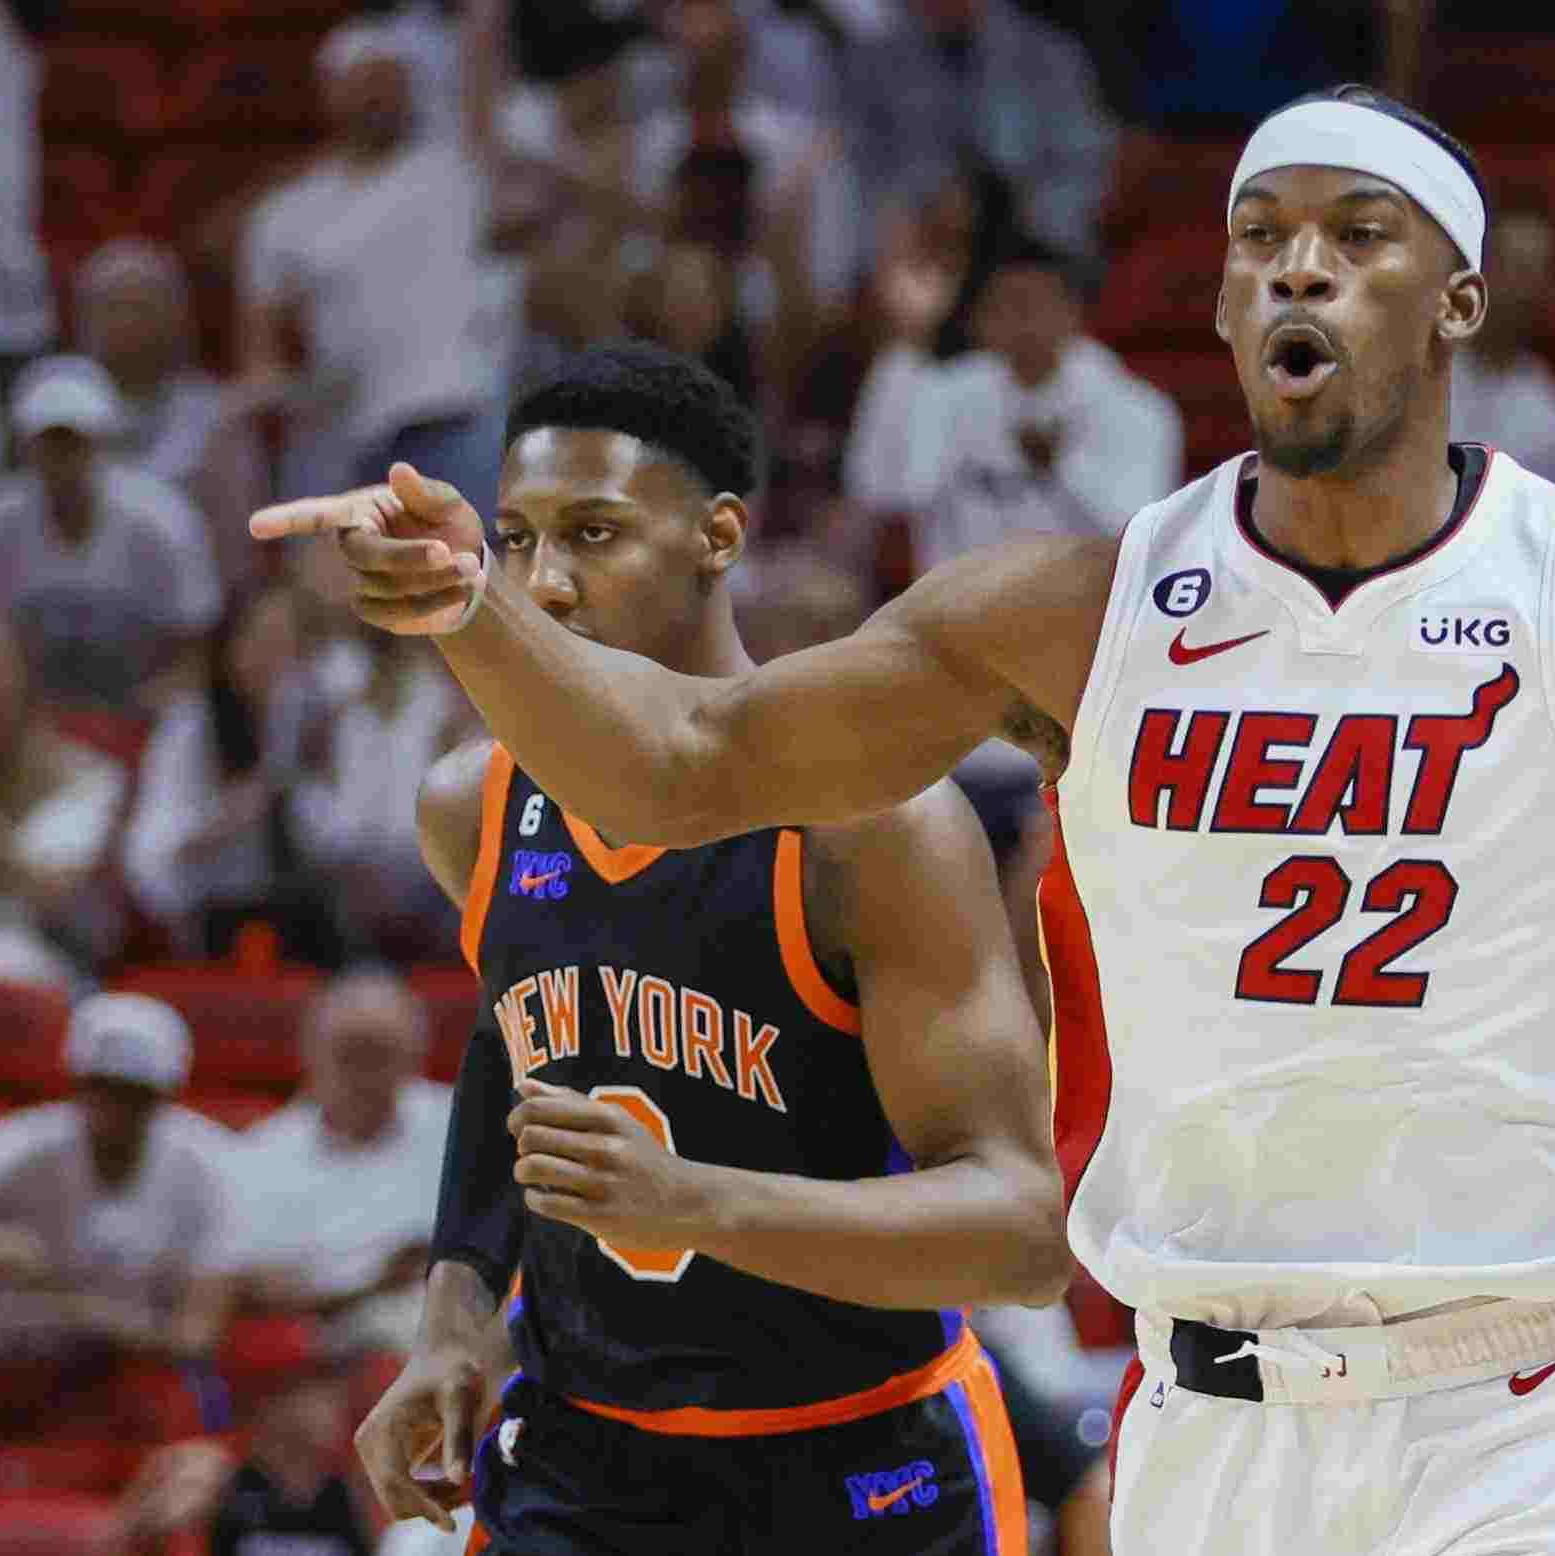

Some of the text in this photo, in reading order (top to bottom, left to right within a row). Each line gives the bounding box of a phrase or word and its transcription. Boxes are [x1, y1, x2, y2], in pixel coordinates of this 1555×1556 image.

[518, 793, 545, 837] 6
[1127, 661, 1520, 836] HEAT
[1234, 854, 1460, 1008] 22
[494, 965, 788, 1113] NEW YORK
